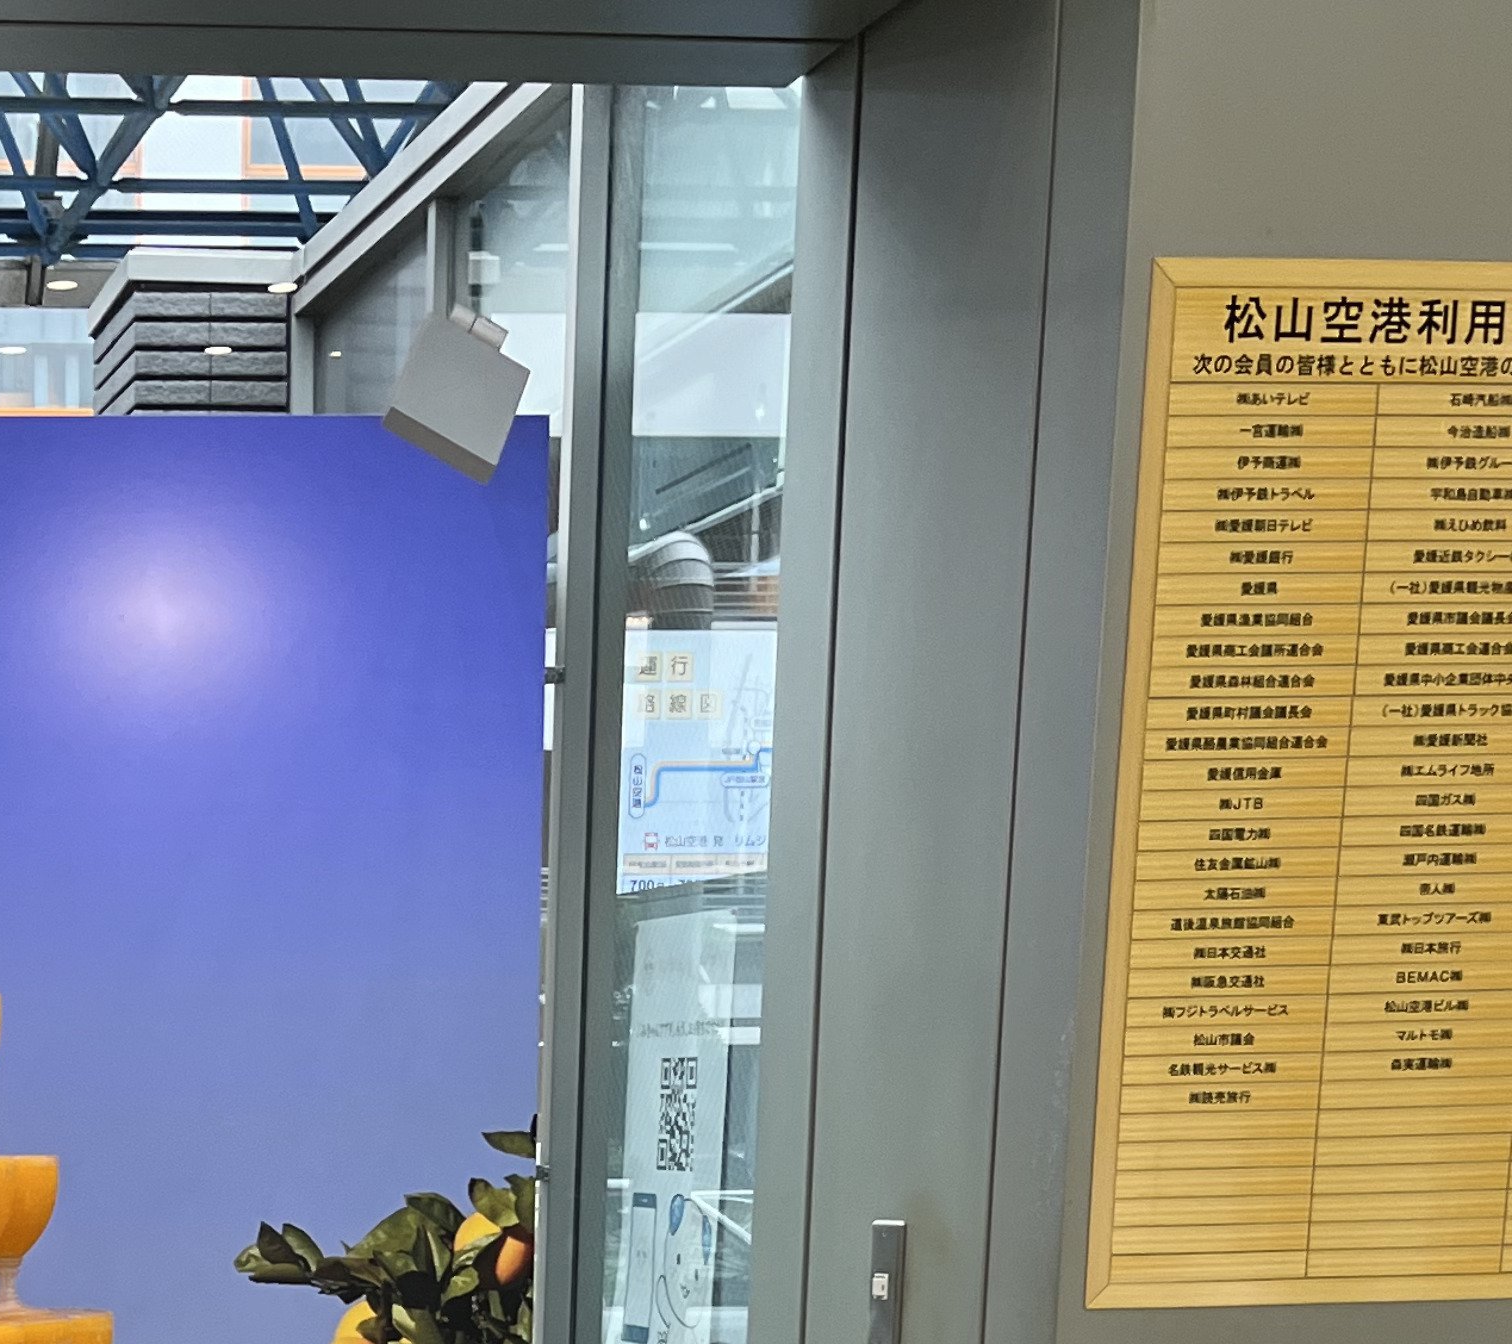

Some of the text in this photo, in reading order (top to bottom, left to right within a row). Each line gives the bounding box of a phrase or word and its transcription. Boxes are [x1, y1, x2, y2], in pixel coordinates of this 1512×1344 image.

[1224, 294, 1506, 345] 松山空港利用
[1193, 353, 1512, 377] 次の会員の皆様とともに松山空港の
